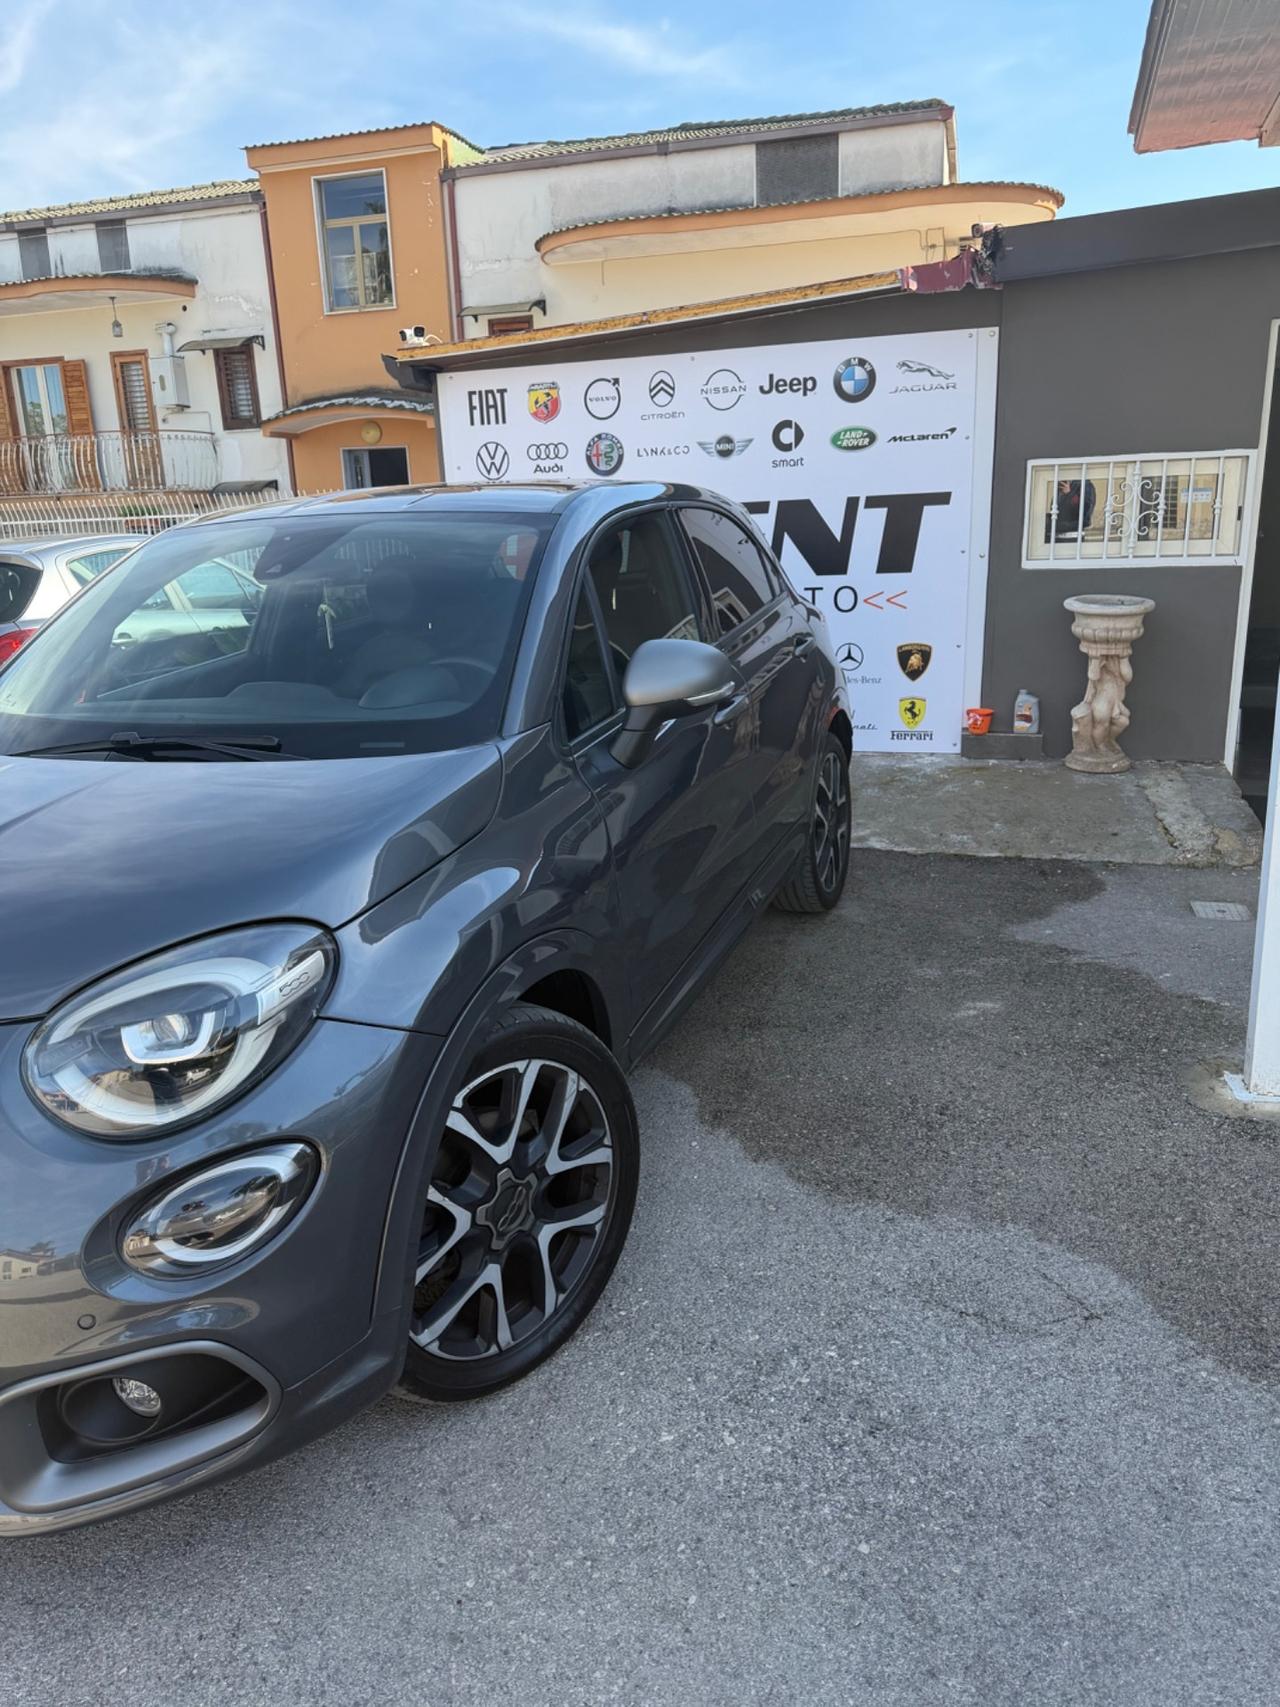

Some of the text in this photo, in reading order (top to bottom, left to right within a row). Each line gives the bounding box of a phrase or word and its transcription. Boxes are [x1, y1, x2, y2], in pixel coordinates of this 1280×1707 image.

[836, 358, 874, 374] BMW
[700, 385, 747, 395] NISSAN
[759, 373, 818, 397] Jeep
[888, 382, 958, 394] JAGUAR
[588, 395, 617, 403] VOLVO
[467, 388, 508, 427] FIAT
[839, 431, 862, 440] LAND
[716, 442, 735, 450] MINI
[841, 437, 870, 447] ROVER
[771, 457, 805, 468] smart
[533, 463, 564, 474] Audi
[741, 491, 952, 576] NT
[890, 730, 934, 741] Ferrari
